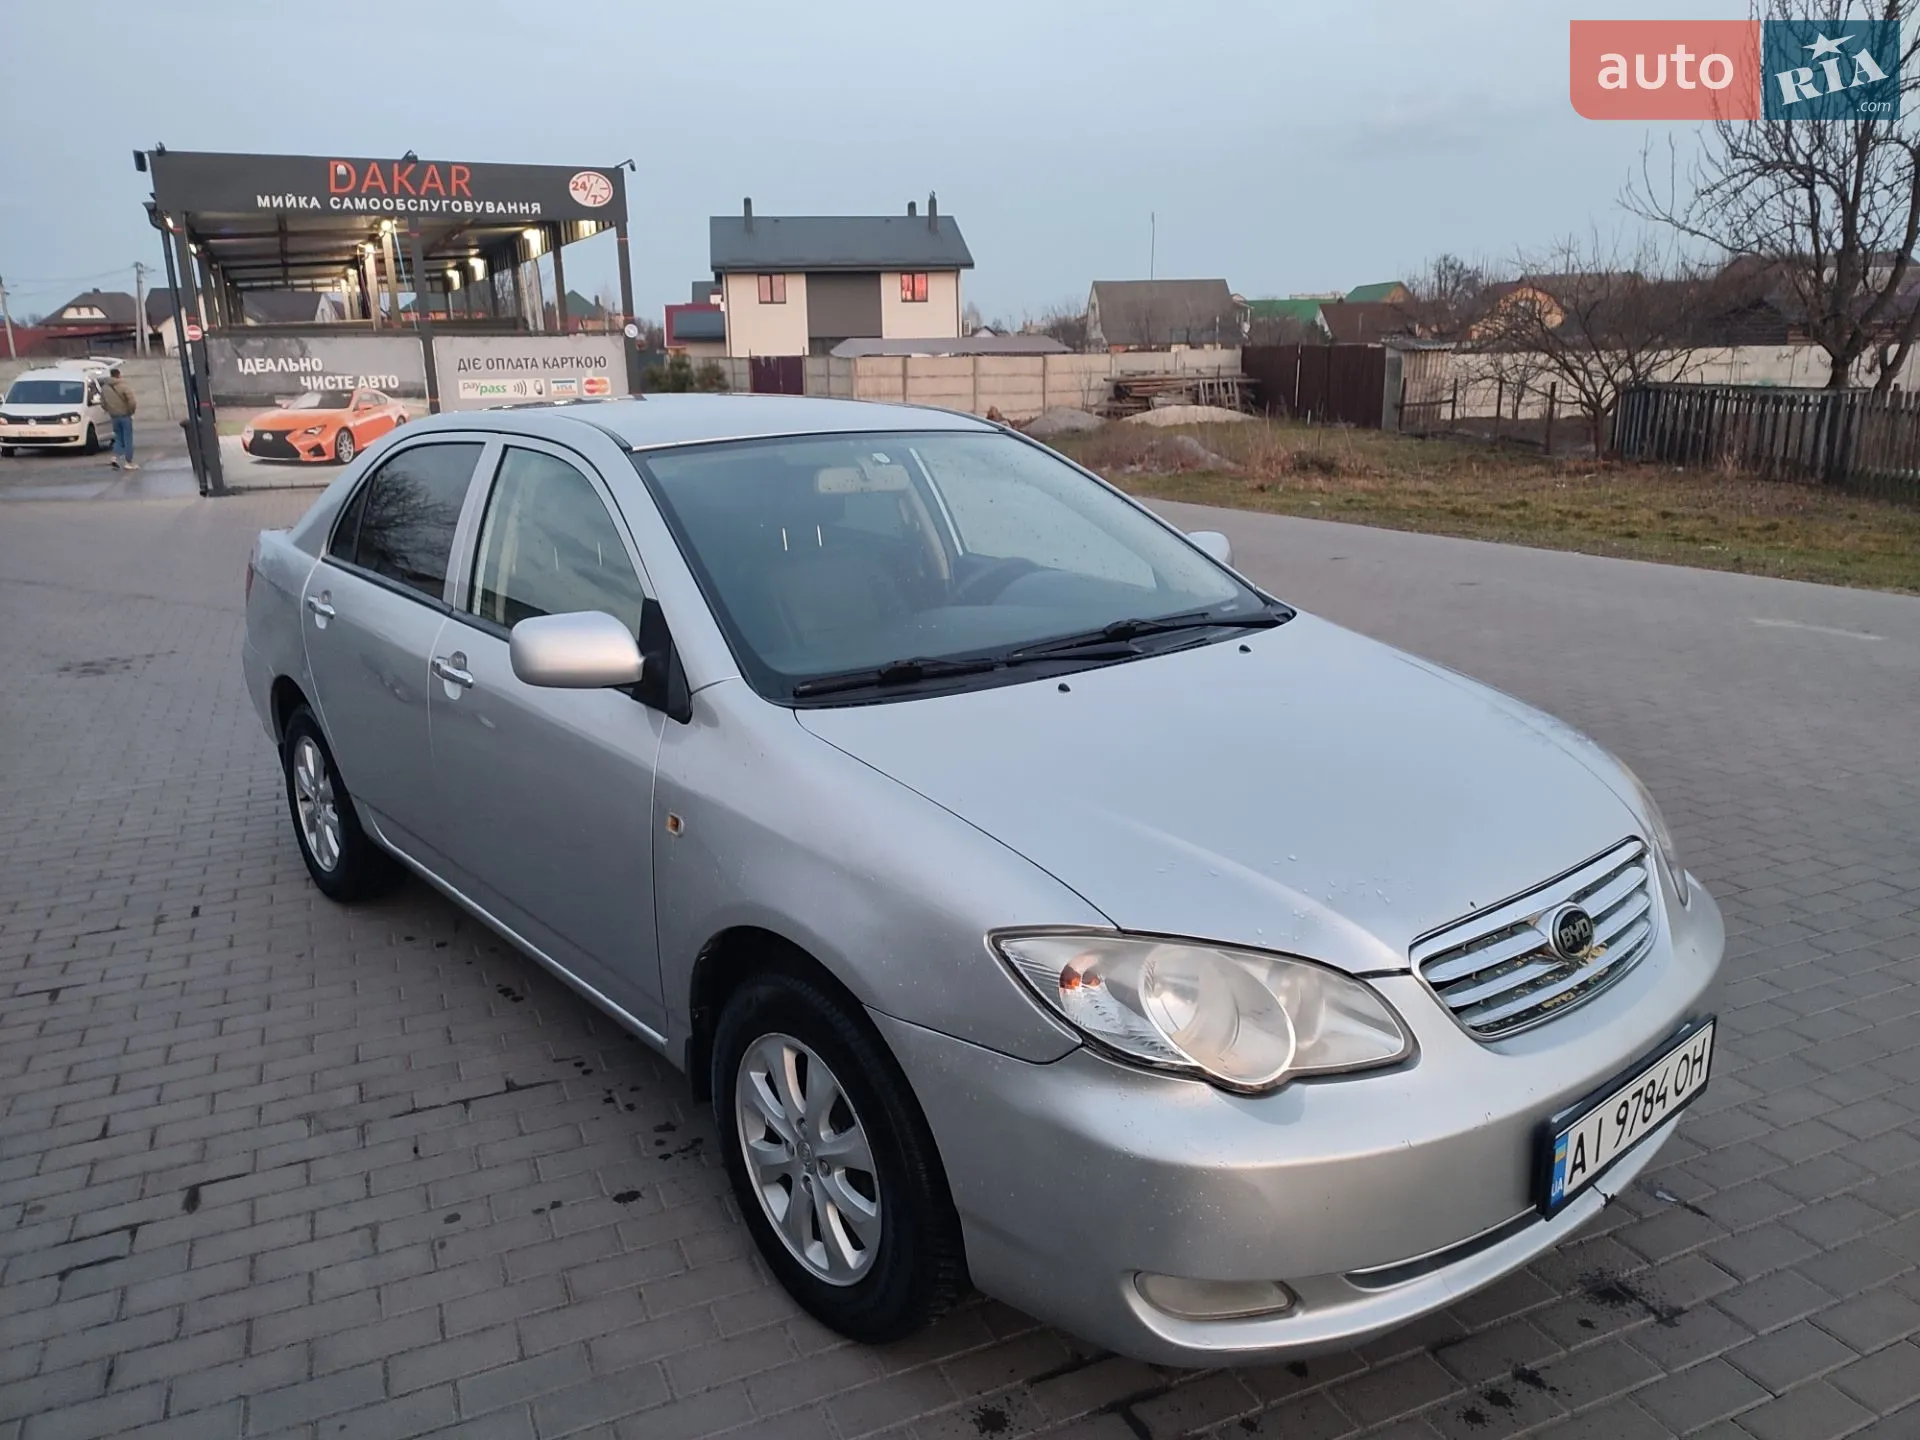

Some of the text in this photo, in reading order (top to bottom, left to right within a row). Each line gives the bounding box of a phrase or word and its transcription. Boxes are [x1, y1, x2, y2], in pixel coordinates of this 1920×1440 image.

[329, 160, 472, 197] DAKAR
[256, 193, 541, 214] МИЙКА САМООБСЛУГОВУВАННЯ
[237, 357, 323, 375] ІДЕАЛЬНО
[457, 355, 607, 372] ДІЄ ОПЛАТА КАРТКОЮ
[300, 375, 399, 390] ЧИСТЕ АВТО
[1560, 918, 1591, 949] BYD
[1568, 1037, 1706, 1186] AI 9784 OH
[1552, 1177, 1563, 1197] UA
